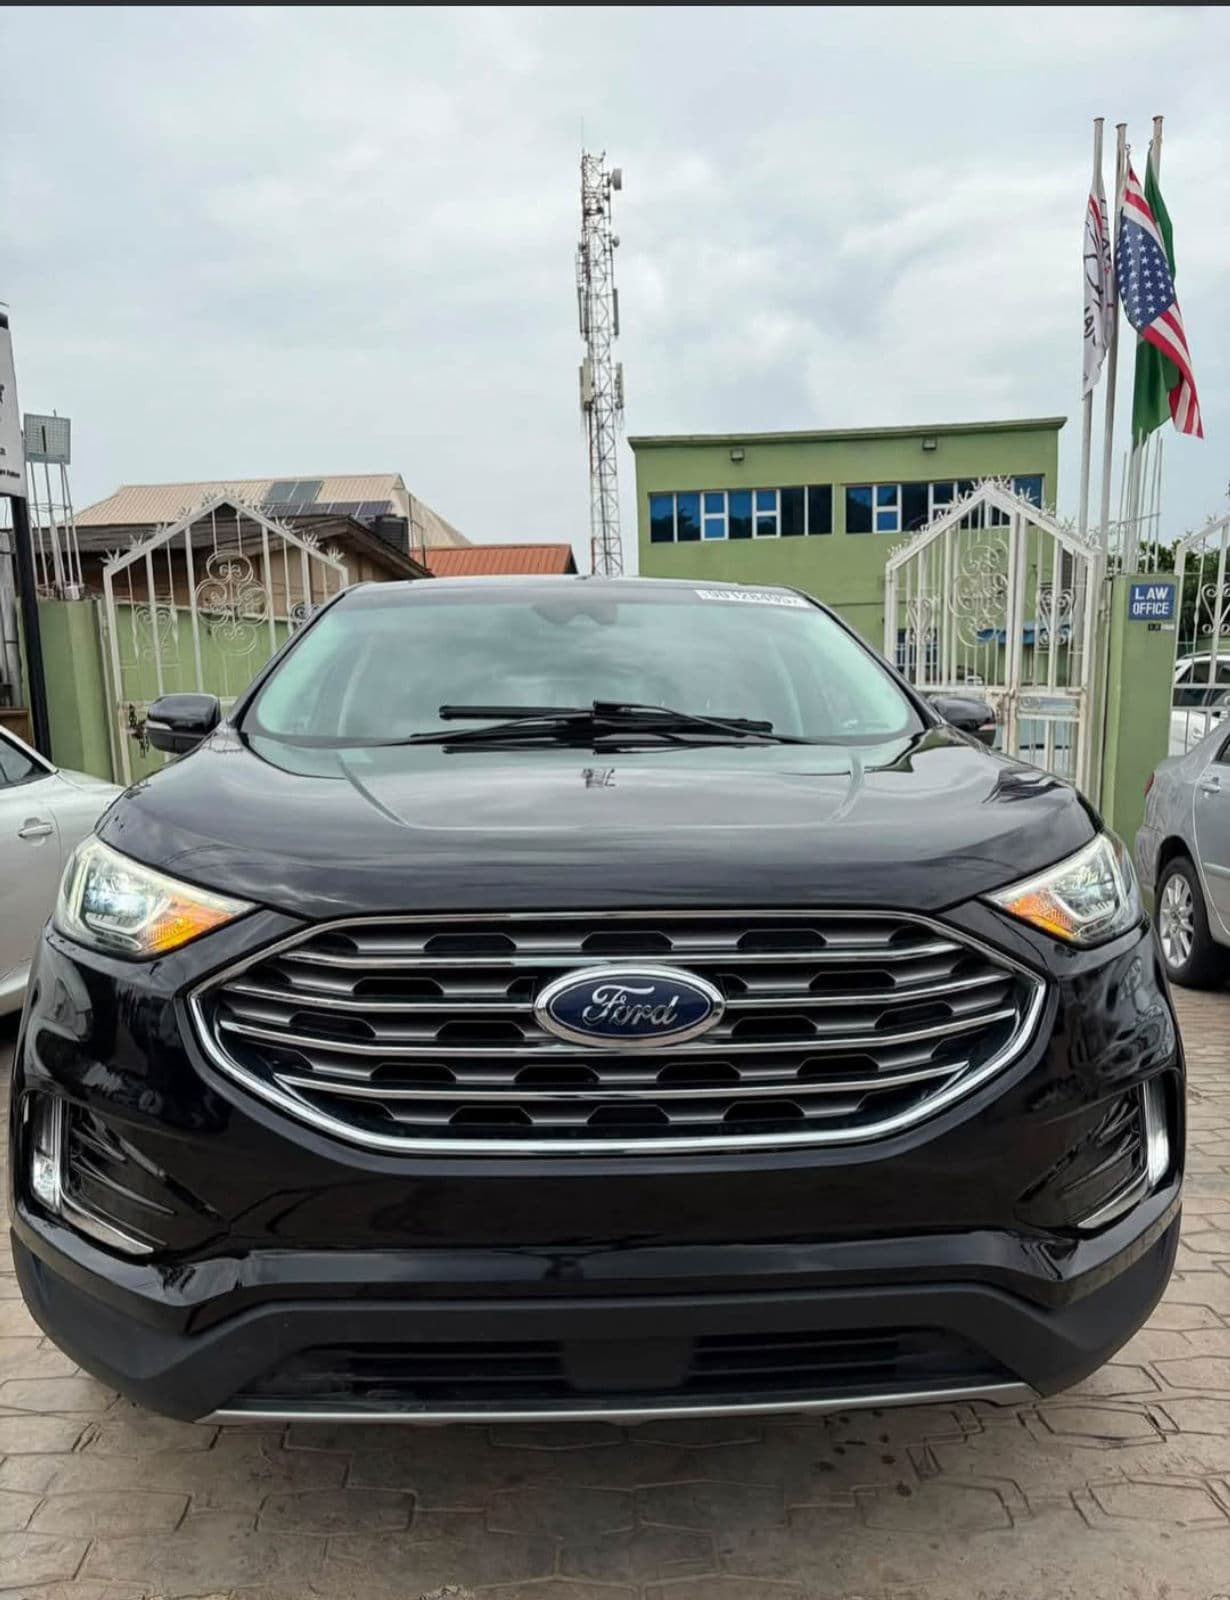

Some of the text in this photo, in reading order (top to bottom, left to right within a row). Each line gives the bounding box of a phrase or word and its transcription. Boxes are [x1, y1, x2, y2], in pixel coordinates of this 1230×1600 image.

[1135, 586, 1169, 600] LAW
[1132, 602, 1169, 616] OFFICE
[581, 984, 680, 1026] Ford
